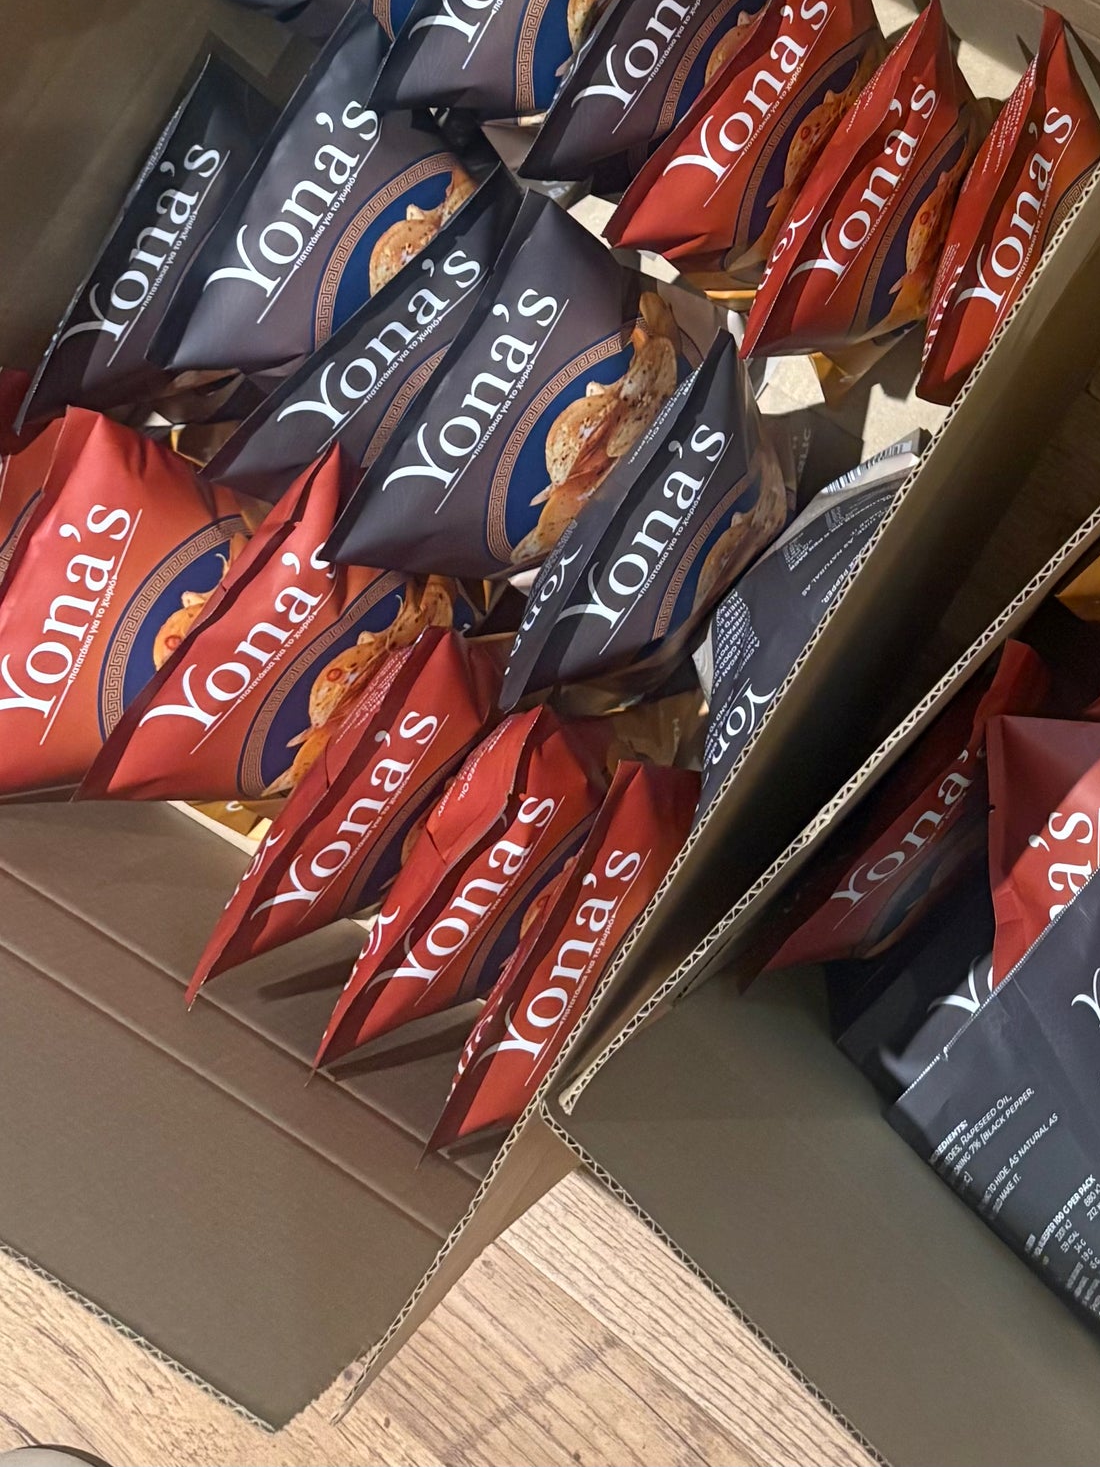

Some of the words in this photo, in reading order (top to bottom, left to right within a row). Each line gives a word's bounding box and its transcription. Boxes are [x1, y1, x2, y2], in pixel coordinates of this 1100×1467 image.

[57, 144, 220, 349] Yona's
[206, 101, 377, 297] Yona's
[790, 84, 936, 280] Yona's
[957, 107, 1072, 313] Yona's
[277, 250, 481, 429] Yona's
[382, 288, 557, 491] Yona's
[0, 504, 130, 718] Yona's
[557, 424, 725, 629] Yona's
[252, 711, 438, 920] Yona's
[830, 748, 974, 904] Yona'
[476, 850, 640, 1071] Yona's
